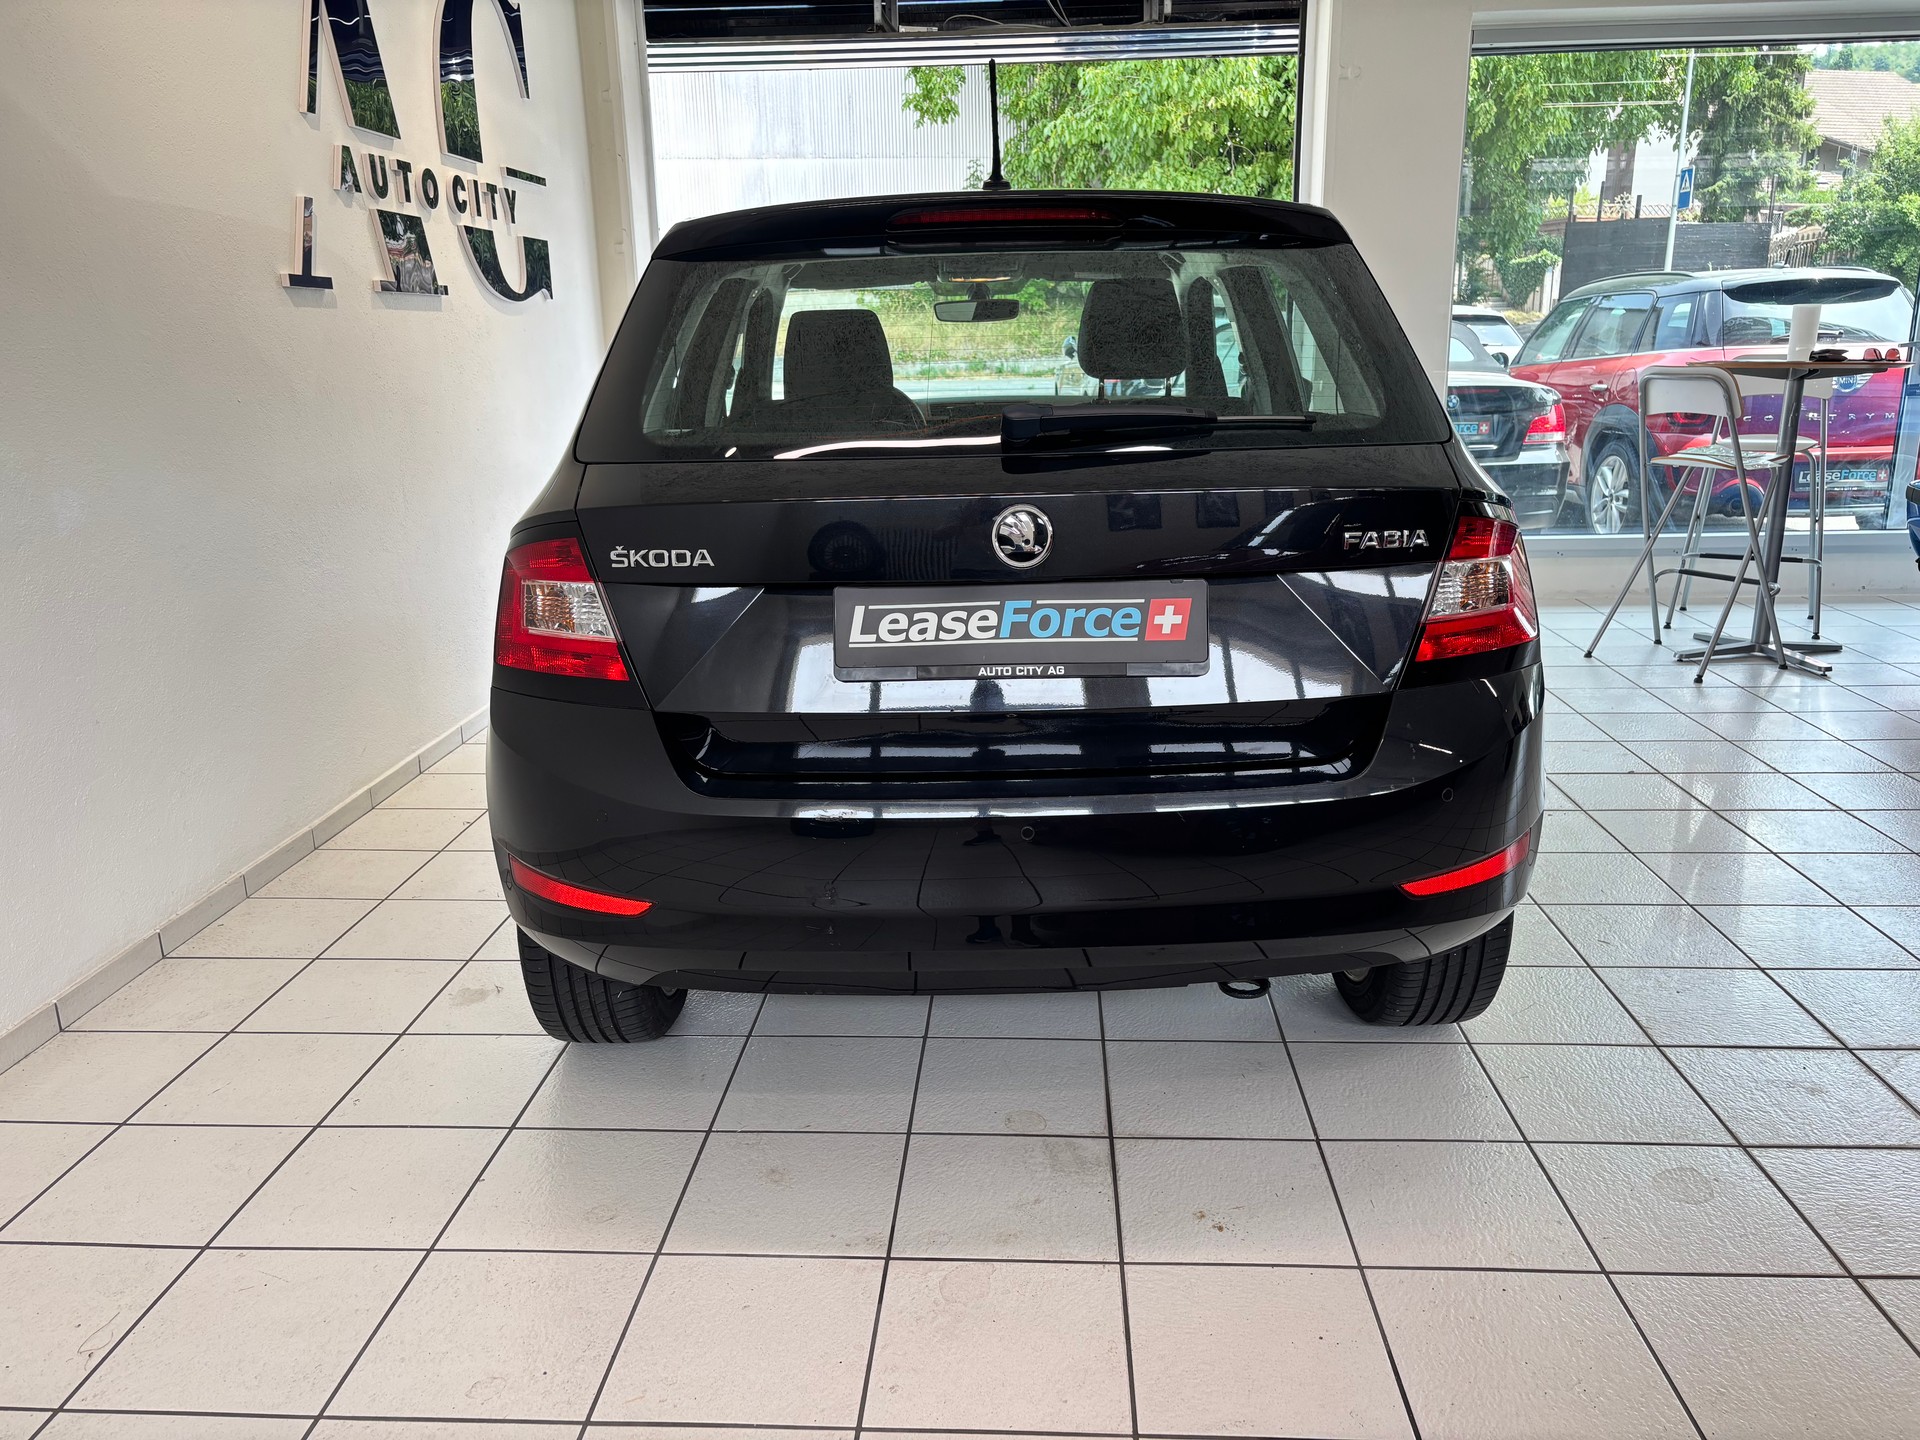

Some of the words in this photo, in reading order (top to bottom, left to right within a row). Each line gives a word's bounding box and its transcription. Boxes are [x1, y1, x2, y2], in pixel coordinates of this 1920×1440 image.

[333, 145, 439, 210] AUTO
[446, 174, 517, 224] CITY
[1344, 530, 1429, 550] FABIA
[610, 545, 715, 568] ŠKODA
[849, 600, 1141, 643] LeaseForce
[978, 667, 1012, 676] AUTO
[1016, 666, 1044, 676] CITY
[1047, 666, 1065, 675] AG
